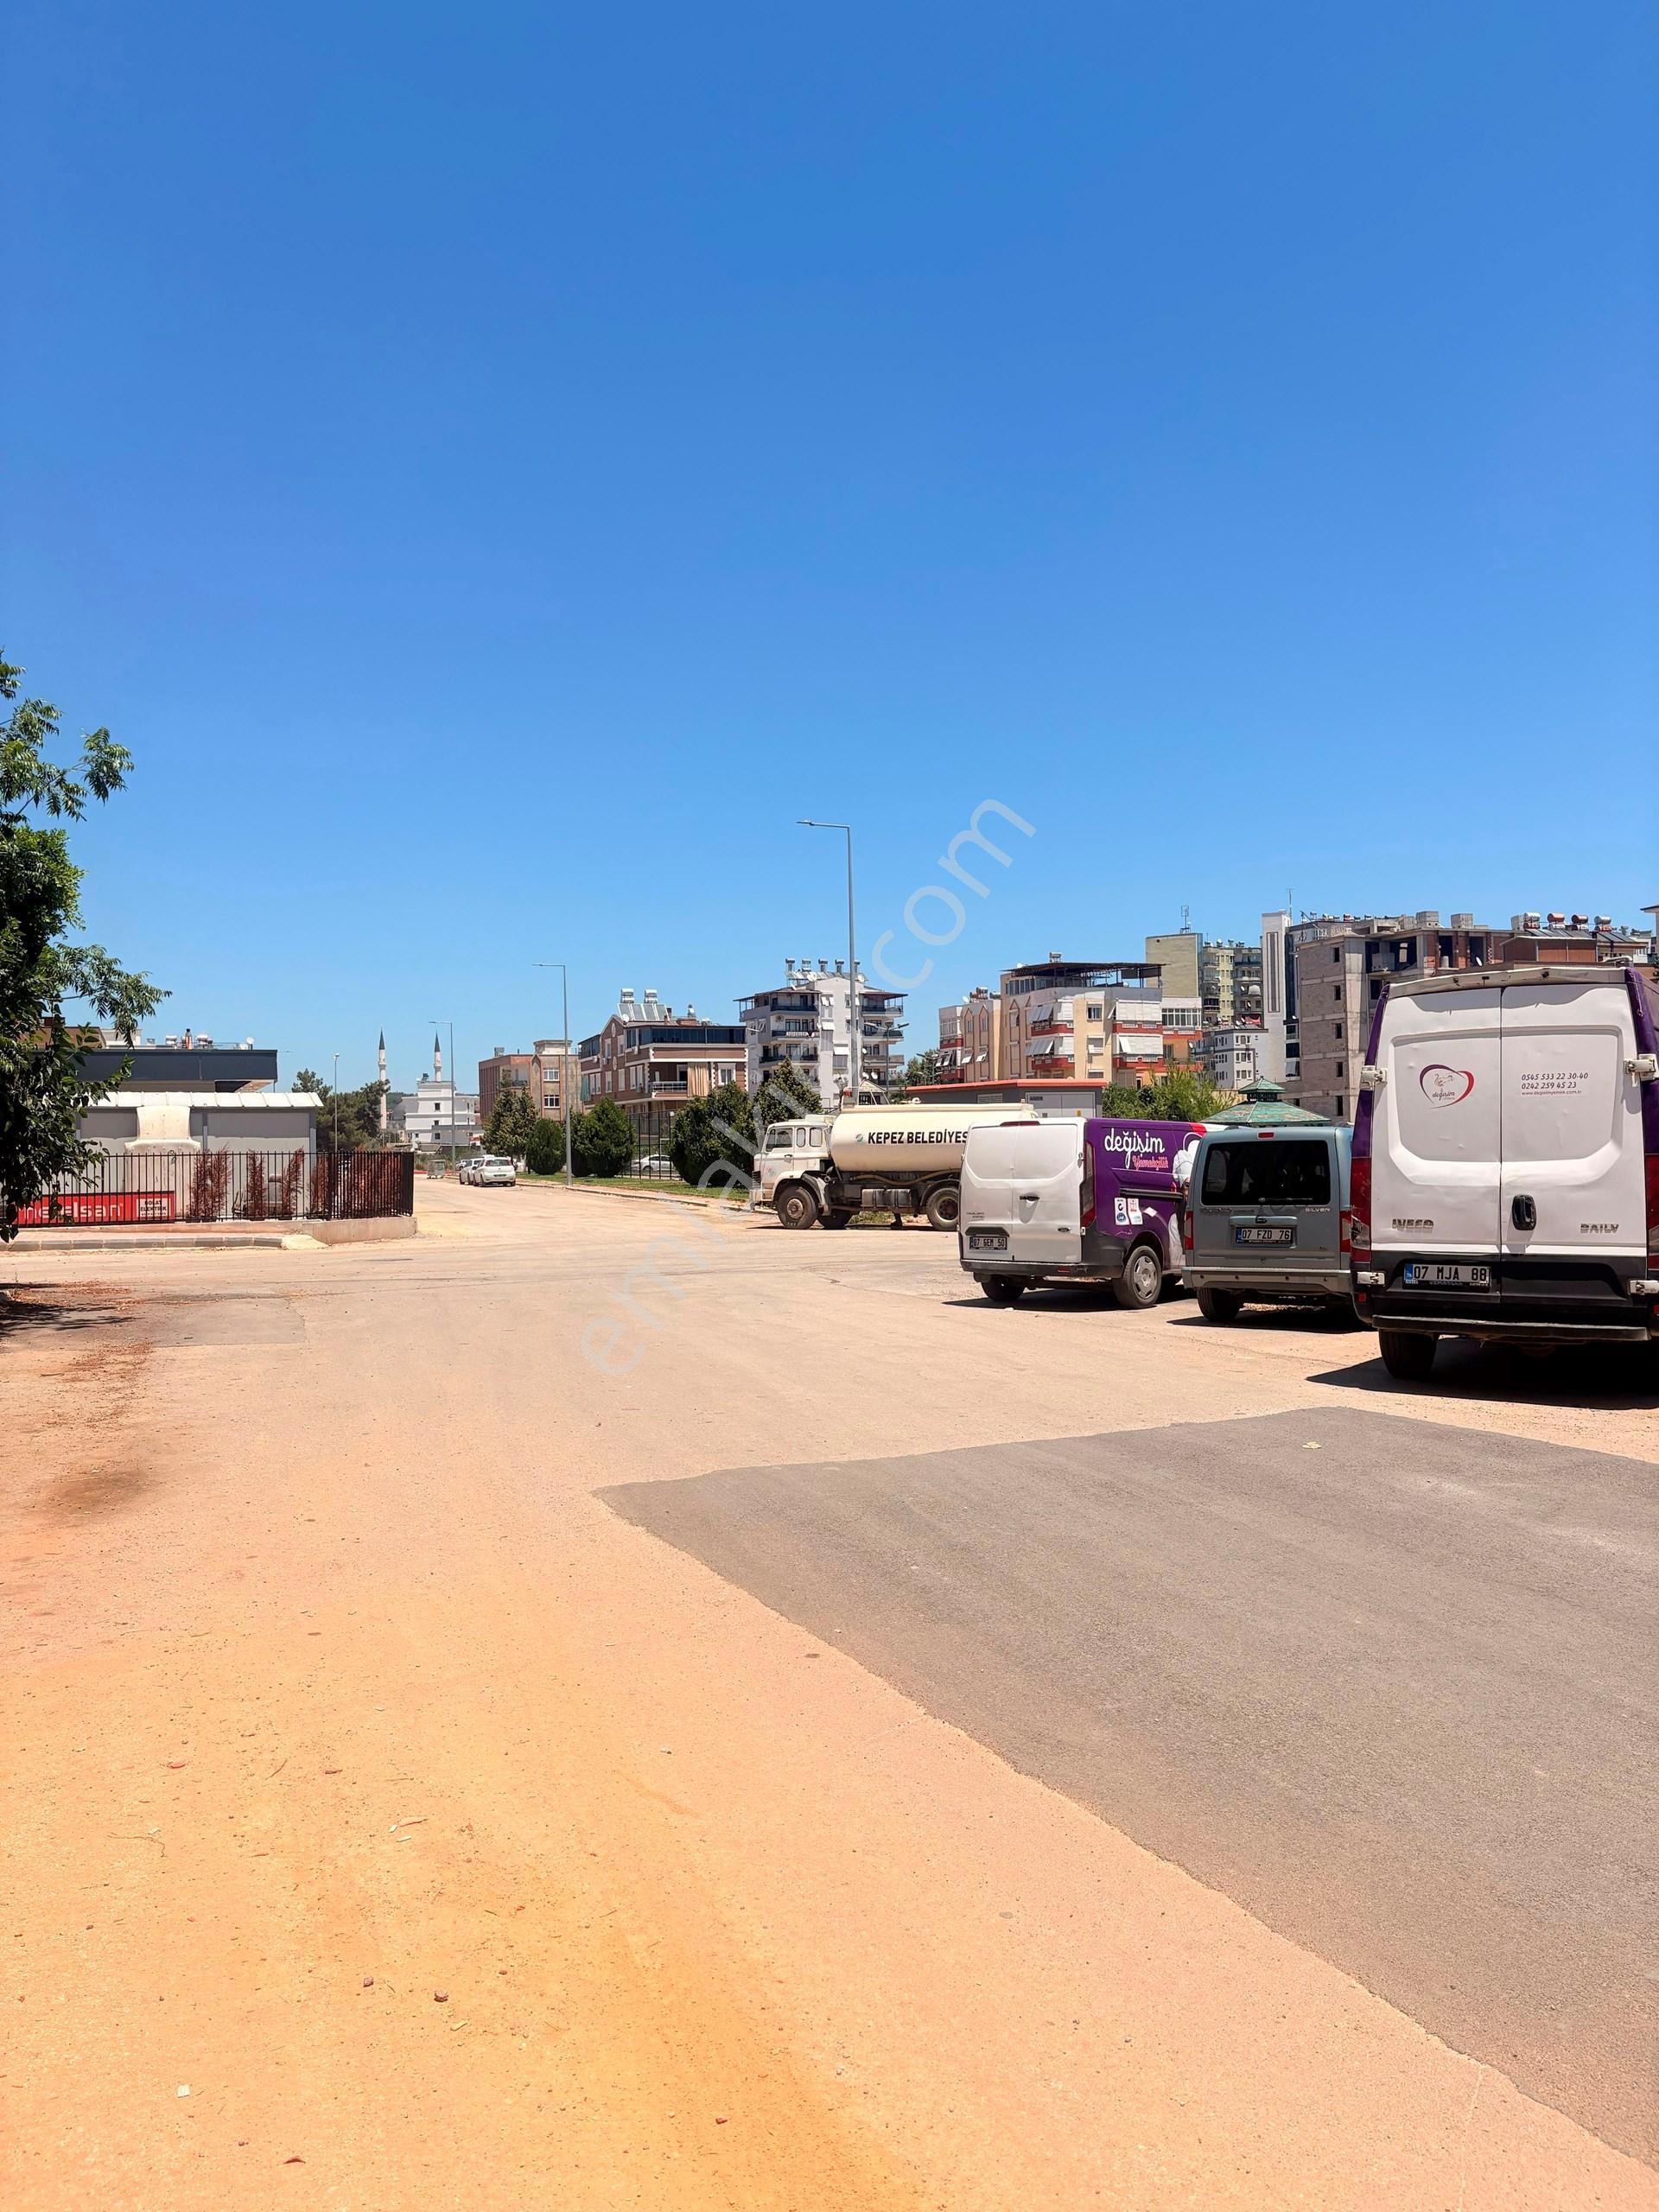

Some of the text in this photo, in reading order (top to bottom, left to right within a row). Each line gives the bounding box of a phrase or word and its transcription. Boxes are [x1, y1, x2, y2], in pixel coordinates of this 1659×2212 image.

[868, 1131, 905, 1144] KEPEZ
[1104, 1128, 1166, 1169] değişim
[1392, 1218, 1434, 1230] IVECO
[1580, 1223, 1619, 1233] DAILY
[1242, 1230, 1291, 1240] 07 FZD 76
[973, 1237, 981, 1248] 07
[997, 1238, 1005, 1248] 50
[1414, 1266, 1487, 1281] 07 MJA 88
